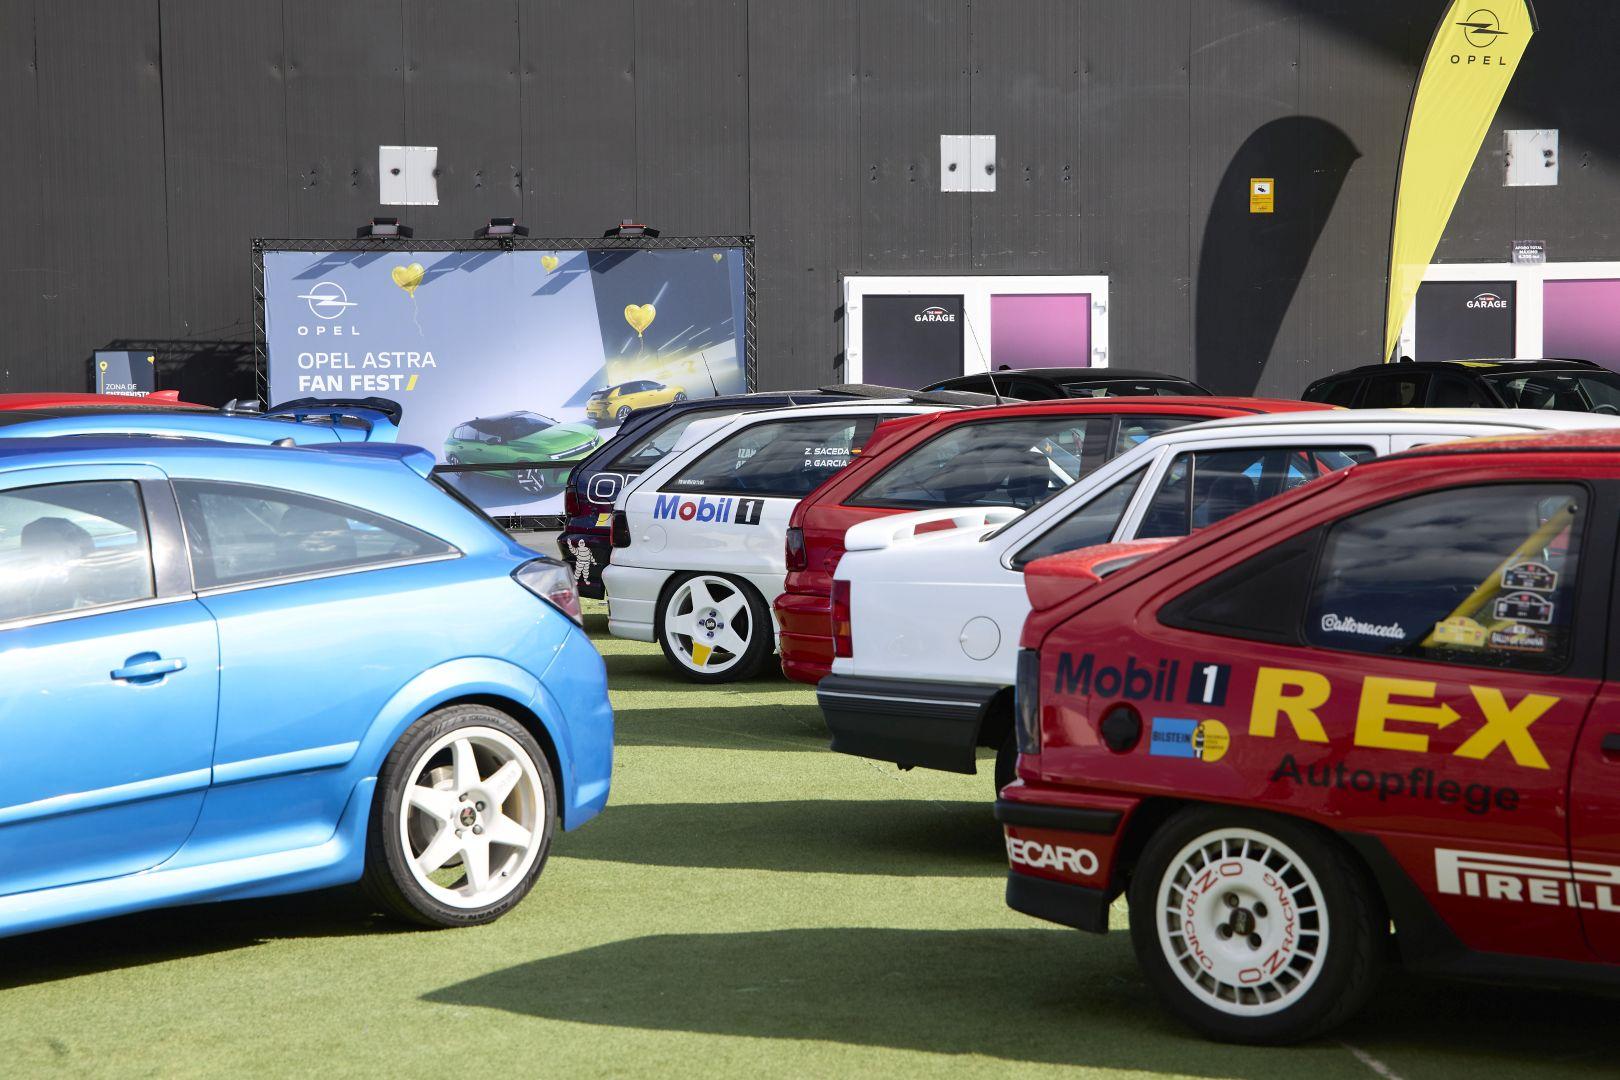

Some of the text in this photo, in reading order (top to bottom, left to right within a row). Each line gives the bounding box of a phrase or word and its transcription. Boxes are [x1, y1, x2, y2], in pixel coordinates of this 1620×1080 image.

[1450, 54, 1507, 66] OPEL
[297, 326, 360, 336] OPEL
[298, 351, 437, 369] OPEL ASTRA
[298, 376, 344, 392] FAN
[653, 494, 733, 523] Mobil
[1053, 652, 1179, 703] Mobil
[1248, 666, 1562, 770] REX
[1152, 731, 1191, 743] BILSTEIN
[1271, 753, 1520, 815] Autopflege
[1005, 834, 1099, 876] ECARO
[1184, 890, 1213, 970] RACING
[1263, 873, 1295, 953] RACING
